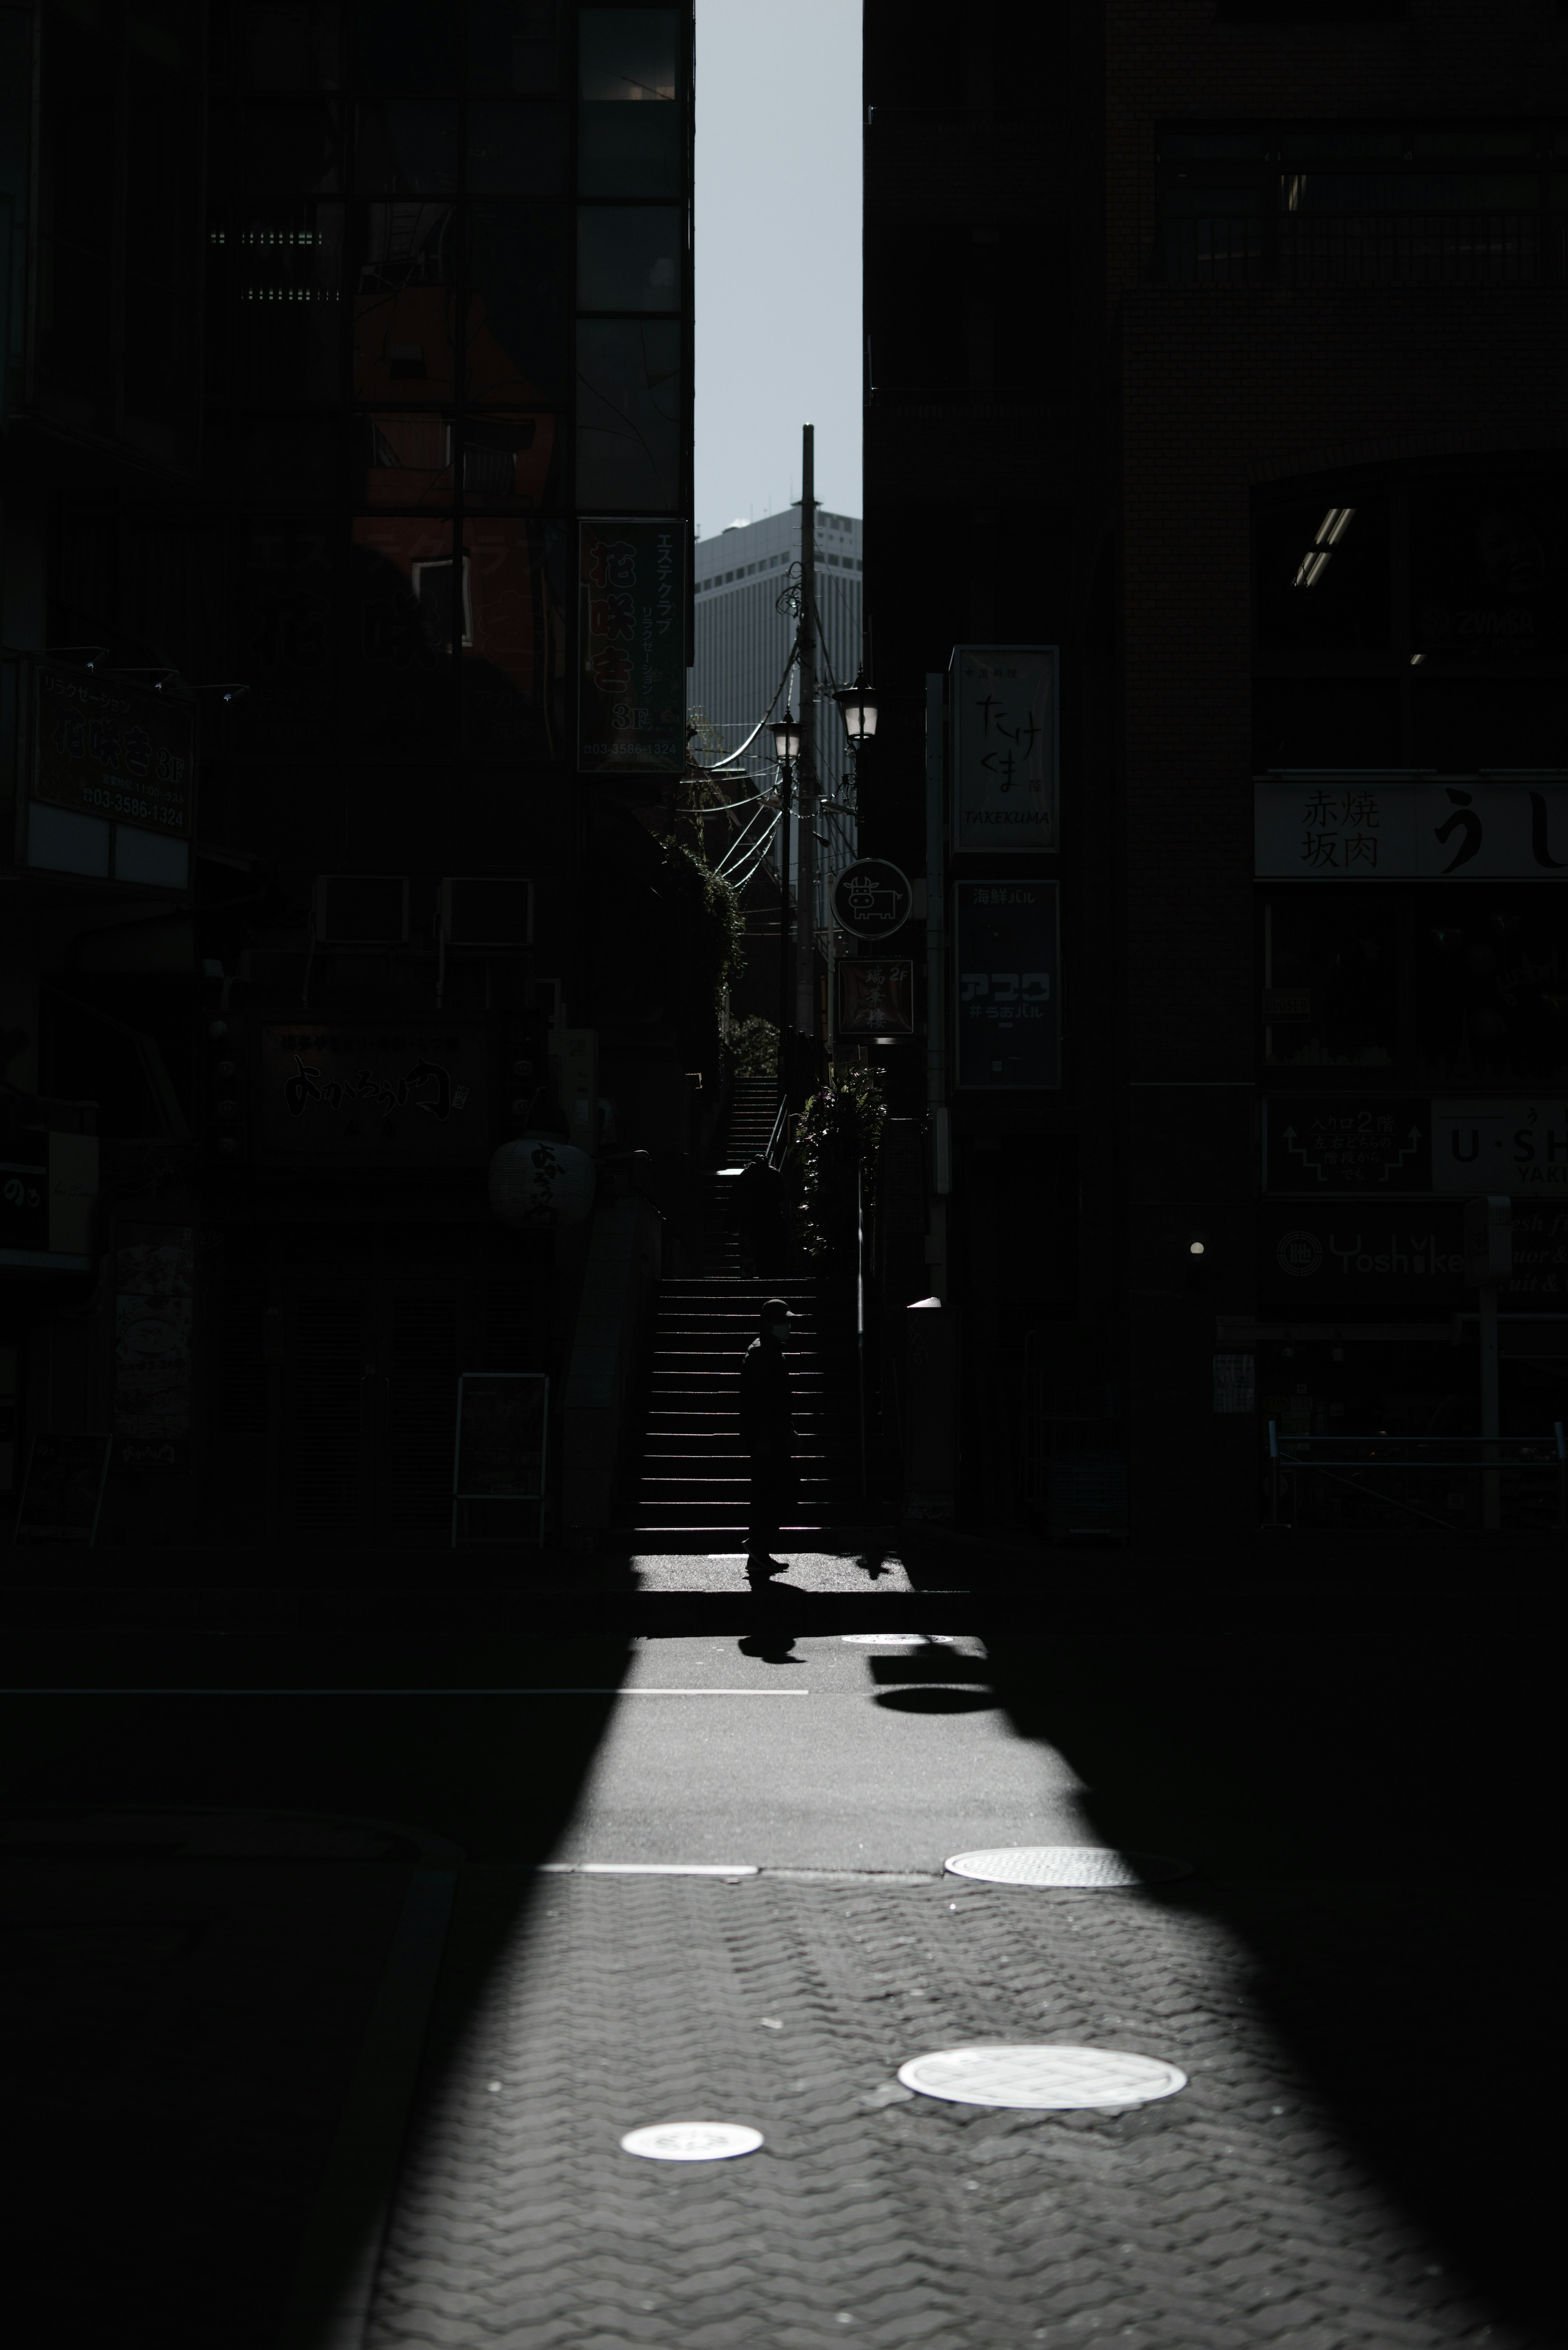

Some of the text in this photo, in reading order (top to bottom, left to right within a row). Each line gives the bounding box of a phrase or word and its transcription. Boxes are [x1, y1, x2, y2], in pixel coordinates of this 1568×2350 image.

[656, 534, 673, 634] エステクラブ
[589, 540, 637, 693] 花咲き
[1456, 610, 1535, 635] ZUMBA
[642, 606, 654, 695] リラクゼーション
[1492, 637, 1535, 649] fitness
[965, 669, 1017, 679] 中国料理
[45, 676, 131, 714] リラクゼーション
[613, 703, 649, 729] 3F
[52, 705, 152, 776] 花咲き
[593, 743, 677, 755] 03-3586-1324
[157, 748, 185, 783] 3F
[93, 790, 184, 828] 03-3586-1324
[965, 811, 1049, 824] TAKEKUMA
[973, 887, 1036, 905] 海鮮バル
[889, 967, 908, 981] 2F
[344, 1120, 397, 1138] 本店
[1309, 1111, 1396, 1133] 入り口2階
[1313, 1136, 1392, 1149] 左右どちらの
[1324, 1151, 1381, 1165] 階段から
[1341, 1168, 1365, 1181] でも
[1512, 1214, 1544, 1232] esh
[1512, 1251, 1549, 1264] uor
[1499, 1273, 1559, 1292] uit &
